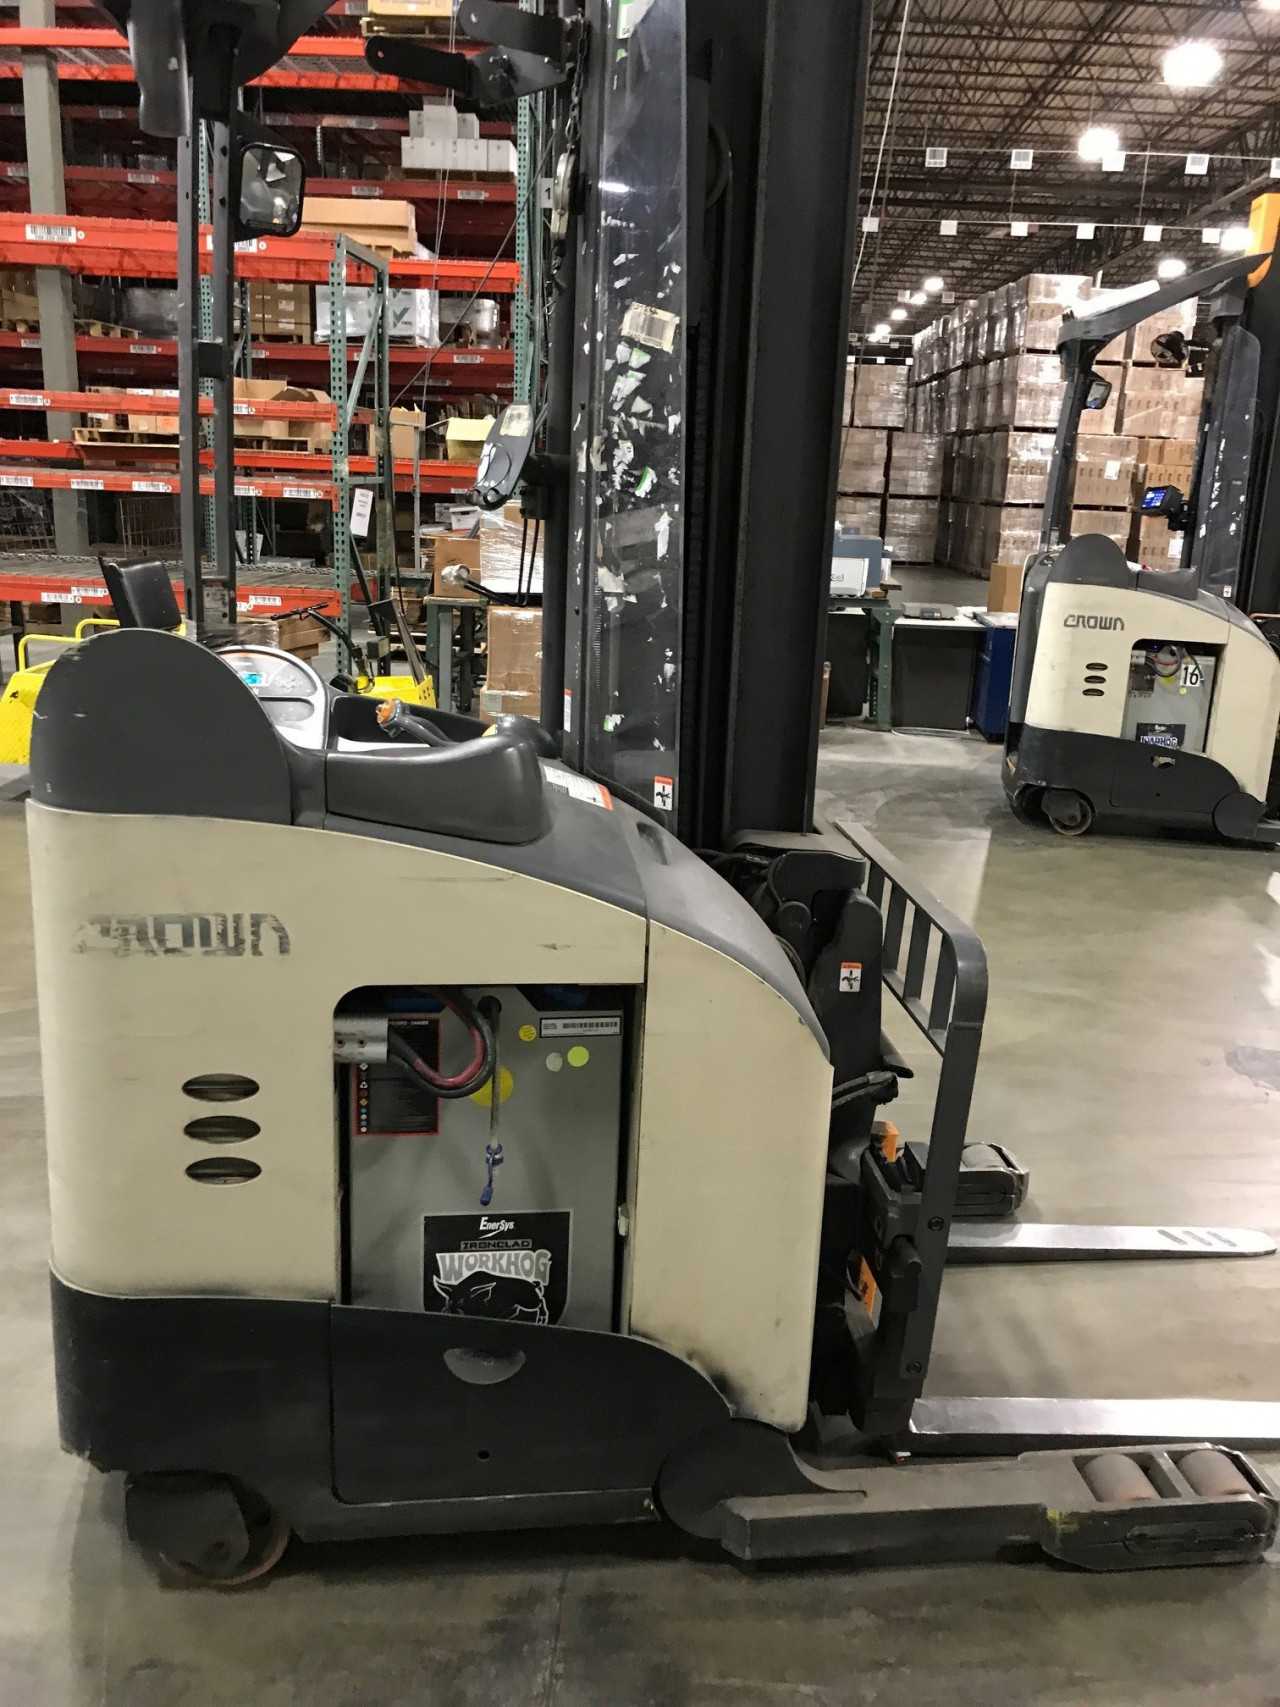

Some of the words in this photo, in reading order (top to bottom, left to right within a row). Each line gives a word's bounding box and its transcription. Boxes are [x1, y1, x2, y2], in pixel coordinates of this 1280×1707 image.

[545, 187, 551, 200] 1
[1064, 614, 1125, 631] CROWN
[1184, 666, 1199, 685] 16
[479, 1217, 515, 1232] EnerSys
[462, 1240, 530, 1251] IRONCLAD
[436, 1249, 552, 1286] WORKHOG
